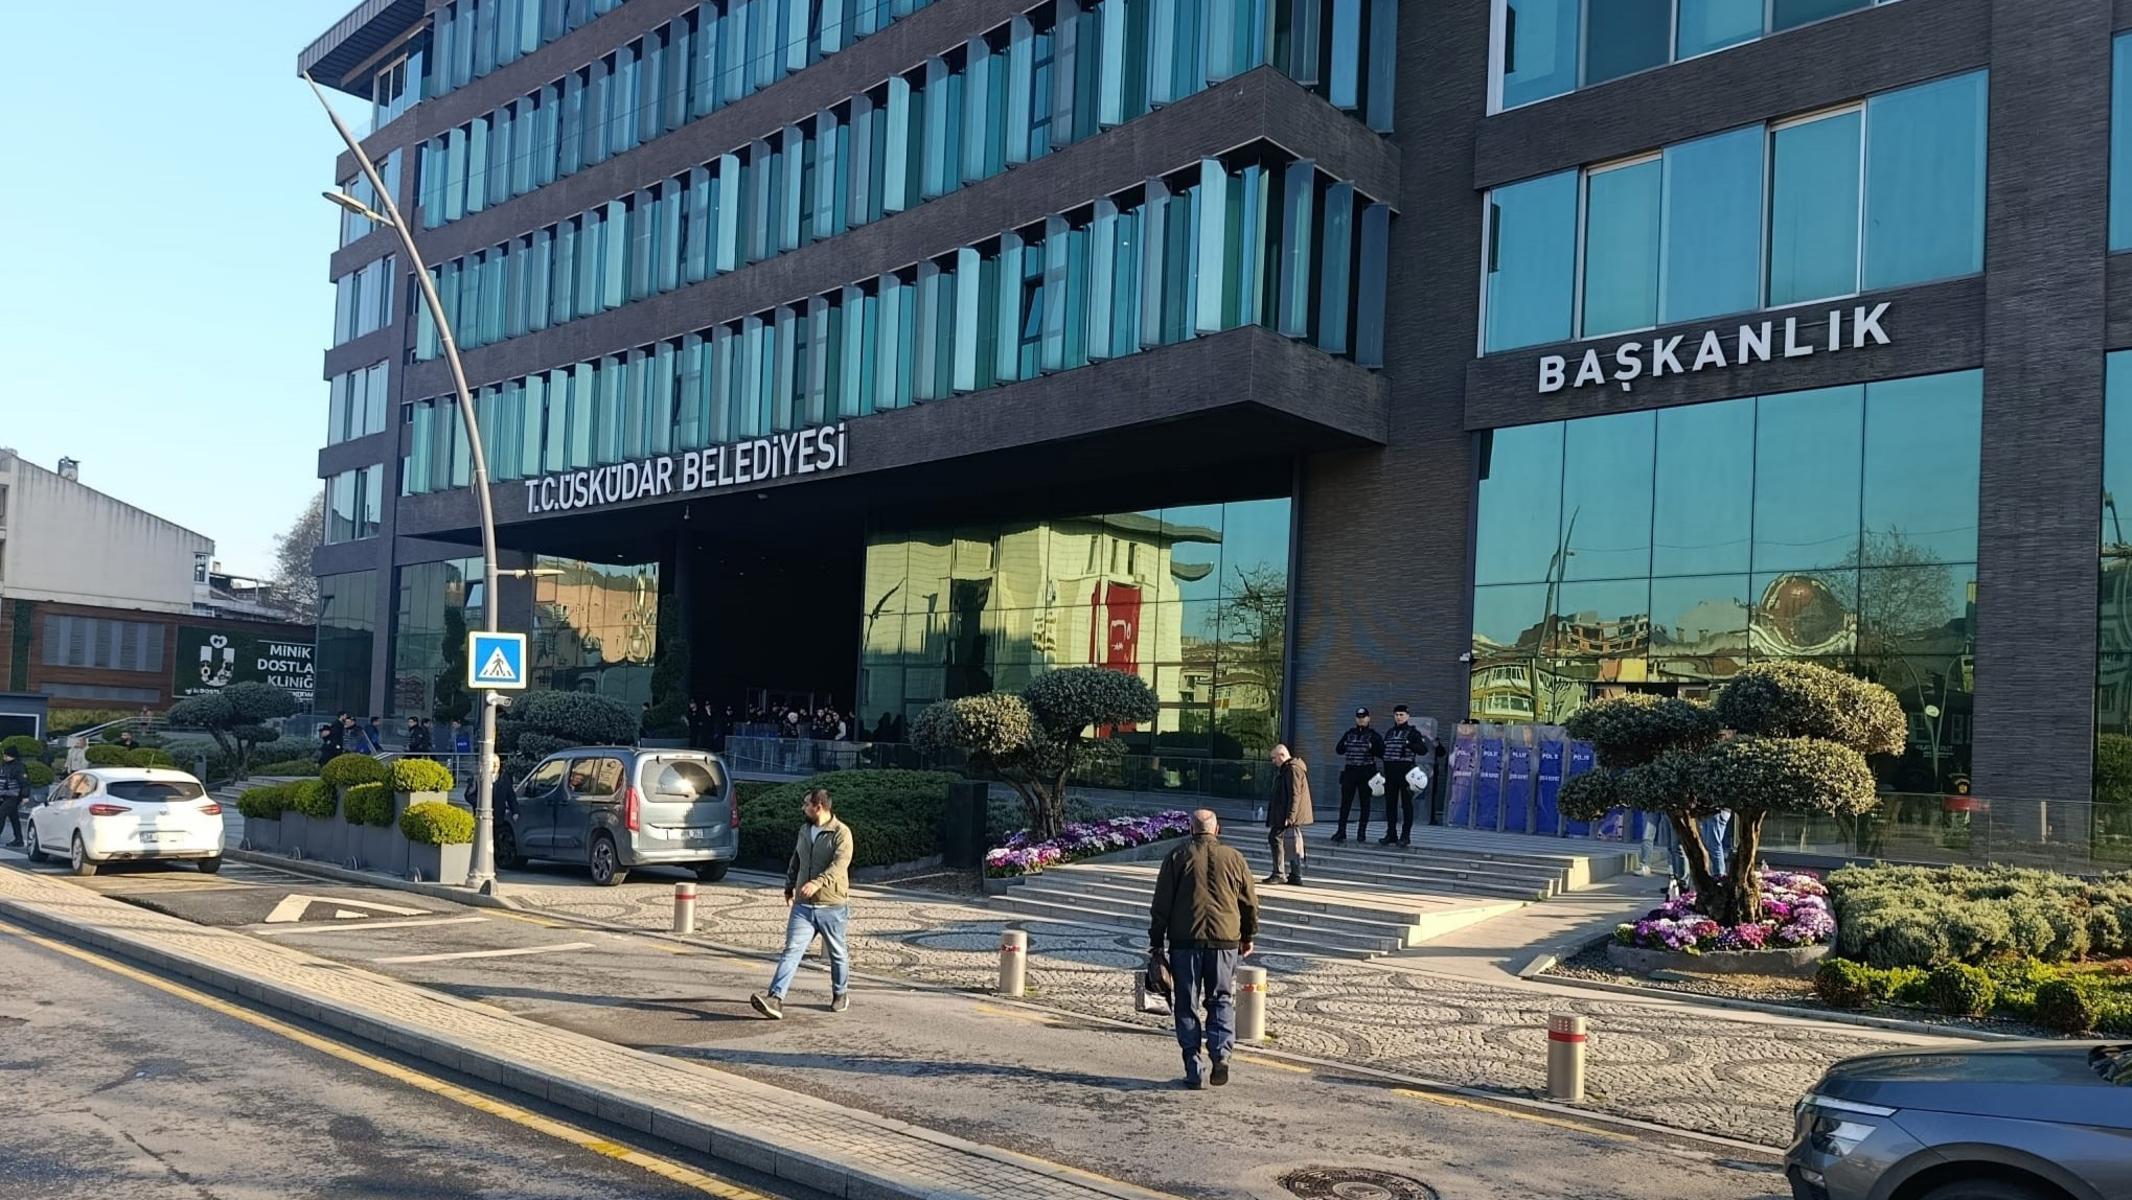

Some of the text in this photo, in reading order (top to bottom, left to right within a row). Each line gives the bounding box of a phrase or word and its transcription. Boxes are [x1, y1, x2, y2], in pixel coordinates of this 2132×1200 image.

[1538, 302, 1892, 393] BAŞKANLIK
[683, 422, 846, 492] BELEDİYESİ
[270, 644, 311, 659] MİNİK
